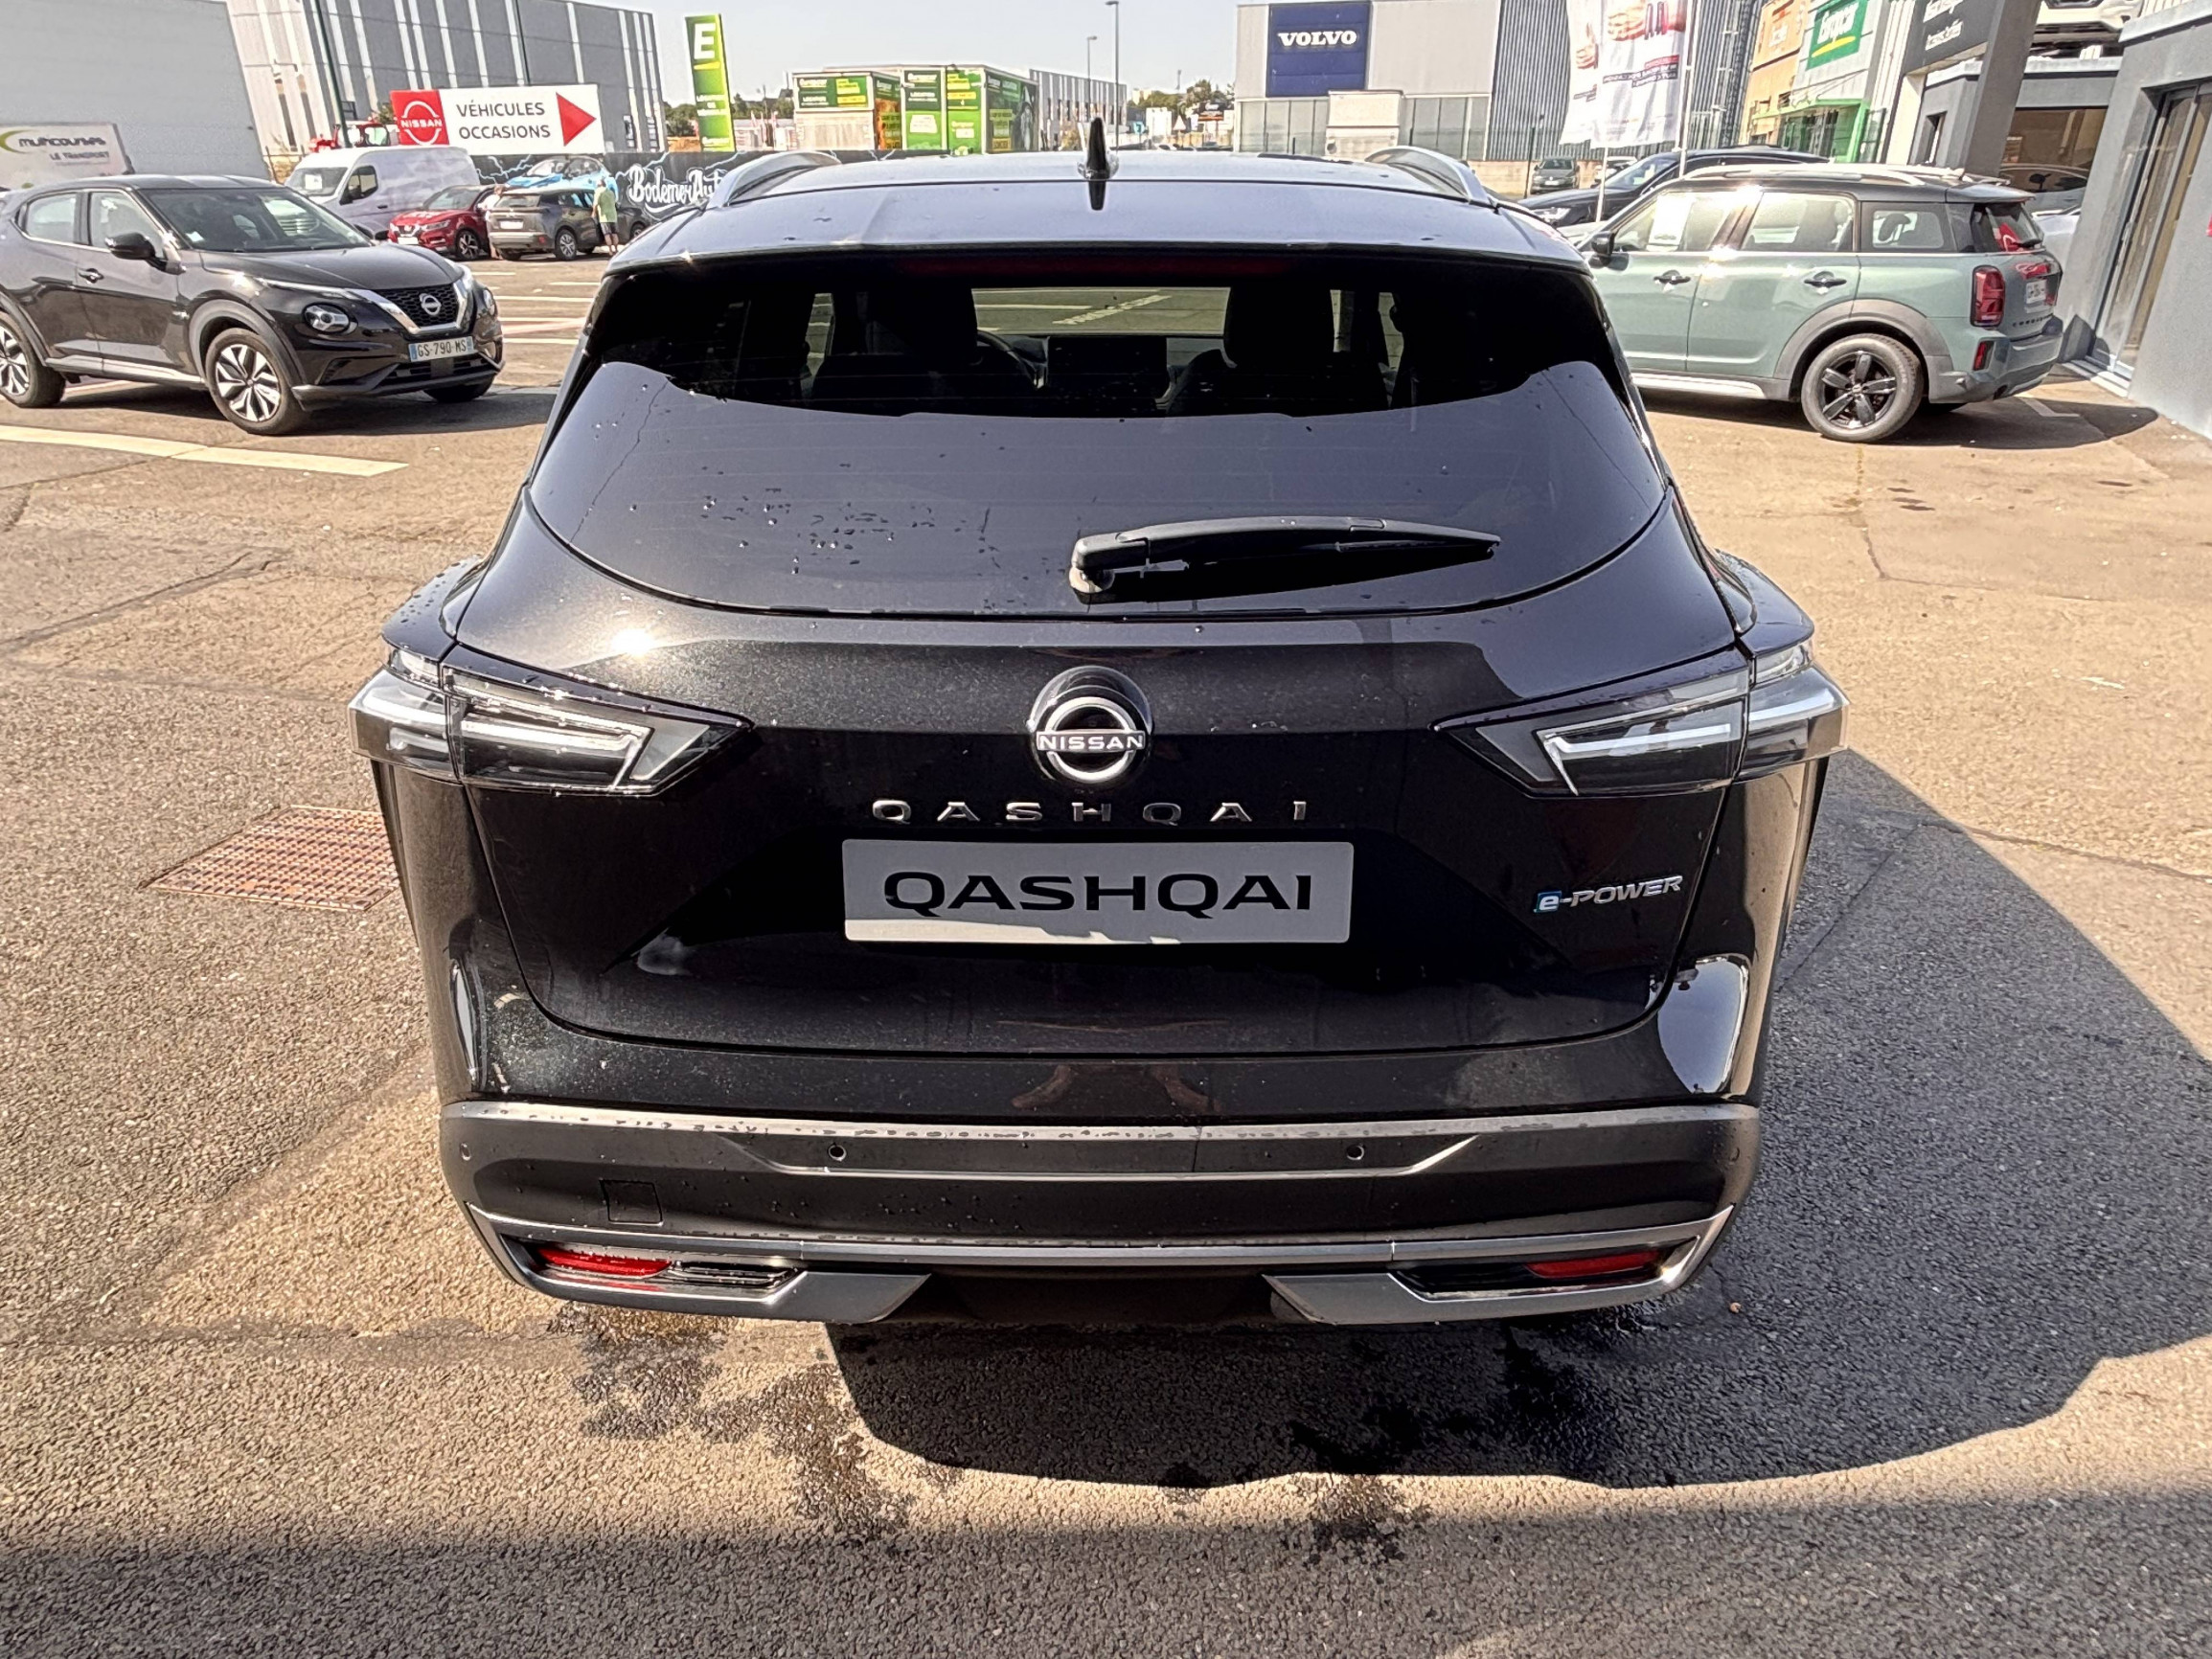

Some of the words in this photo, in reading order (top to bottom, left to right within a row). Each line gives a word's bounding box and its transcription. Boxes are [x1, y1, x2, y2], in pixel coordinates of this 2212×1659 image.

[694, 23, 717, 59] E
[1277, 30, 1357, 47] VOLVO
[456, 100, 545, 117] VÉHICULES
[400, 118, 443, 128] NISSAN
[459, 125, 551, 140] OCCASIONS
[1038, 735, 1144, 750] NISSAN
[872, 799, 1308, 826] QASHQAI
[883, 871, 1312, 919] QASHQAI
